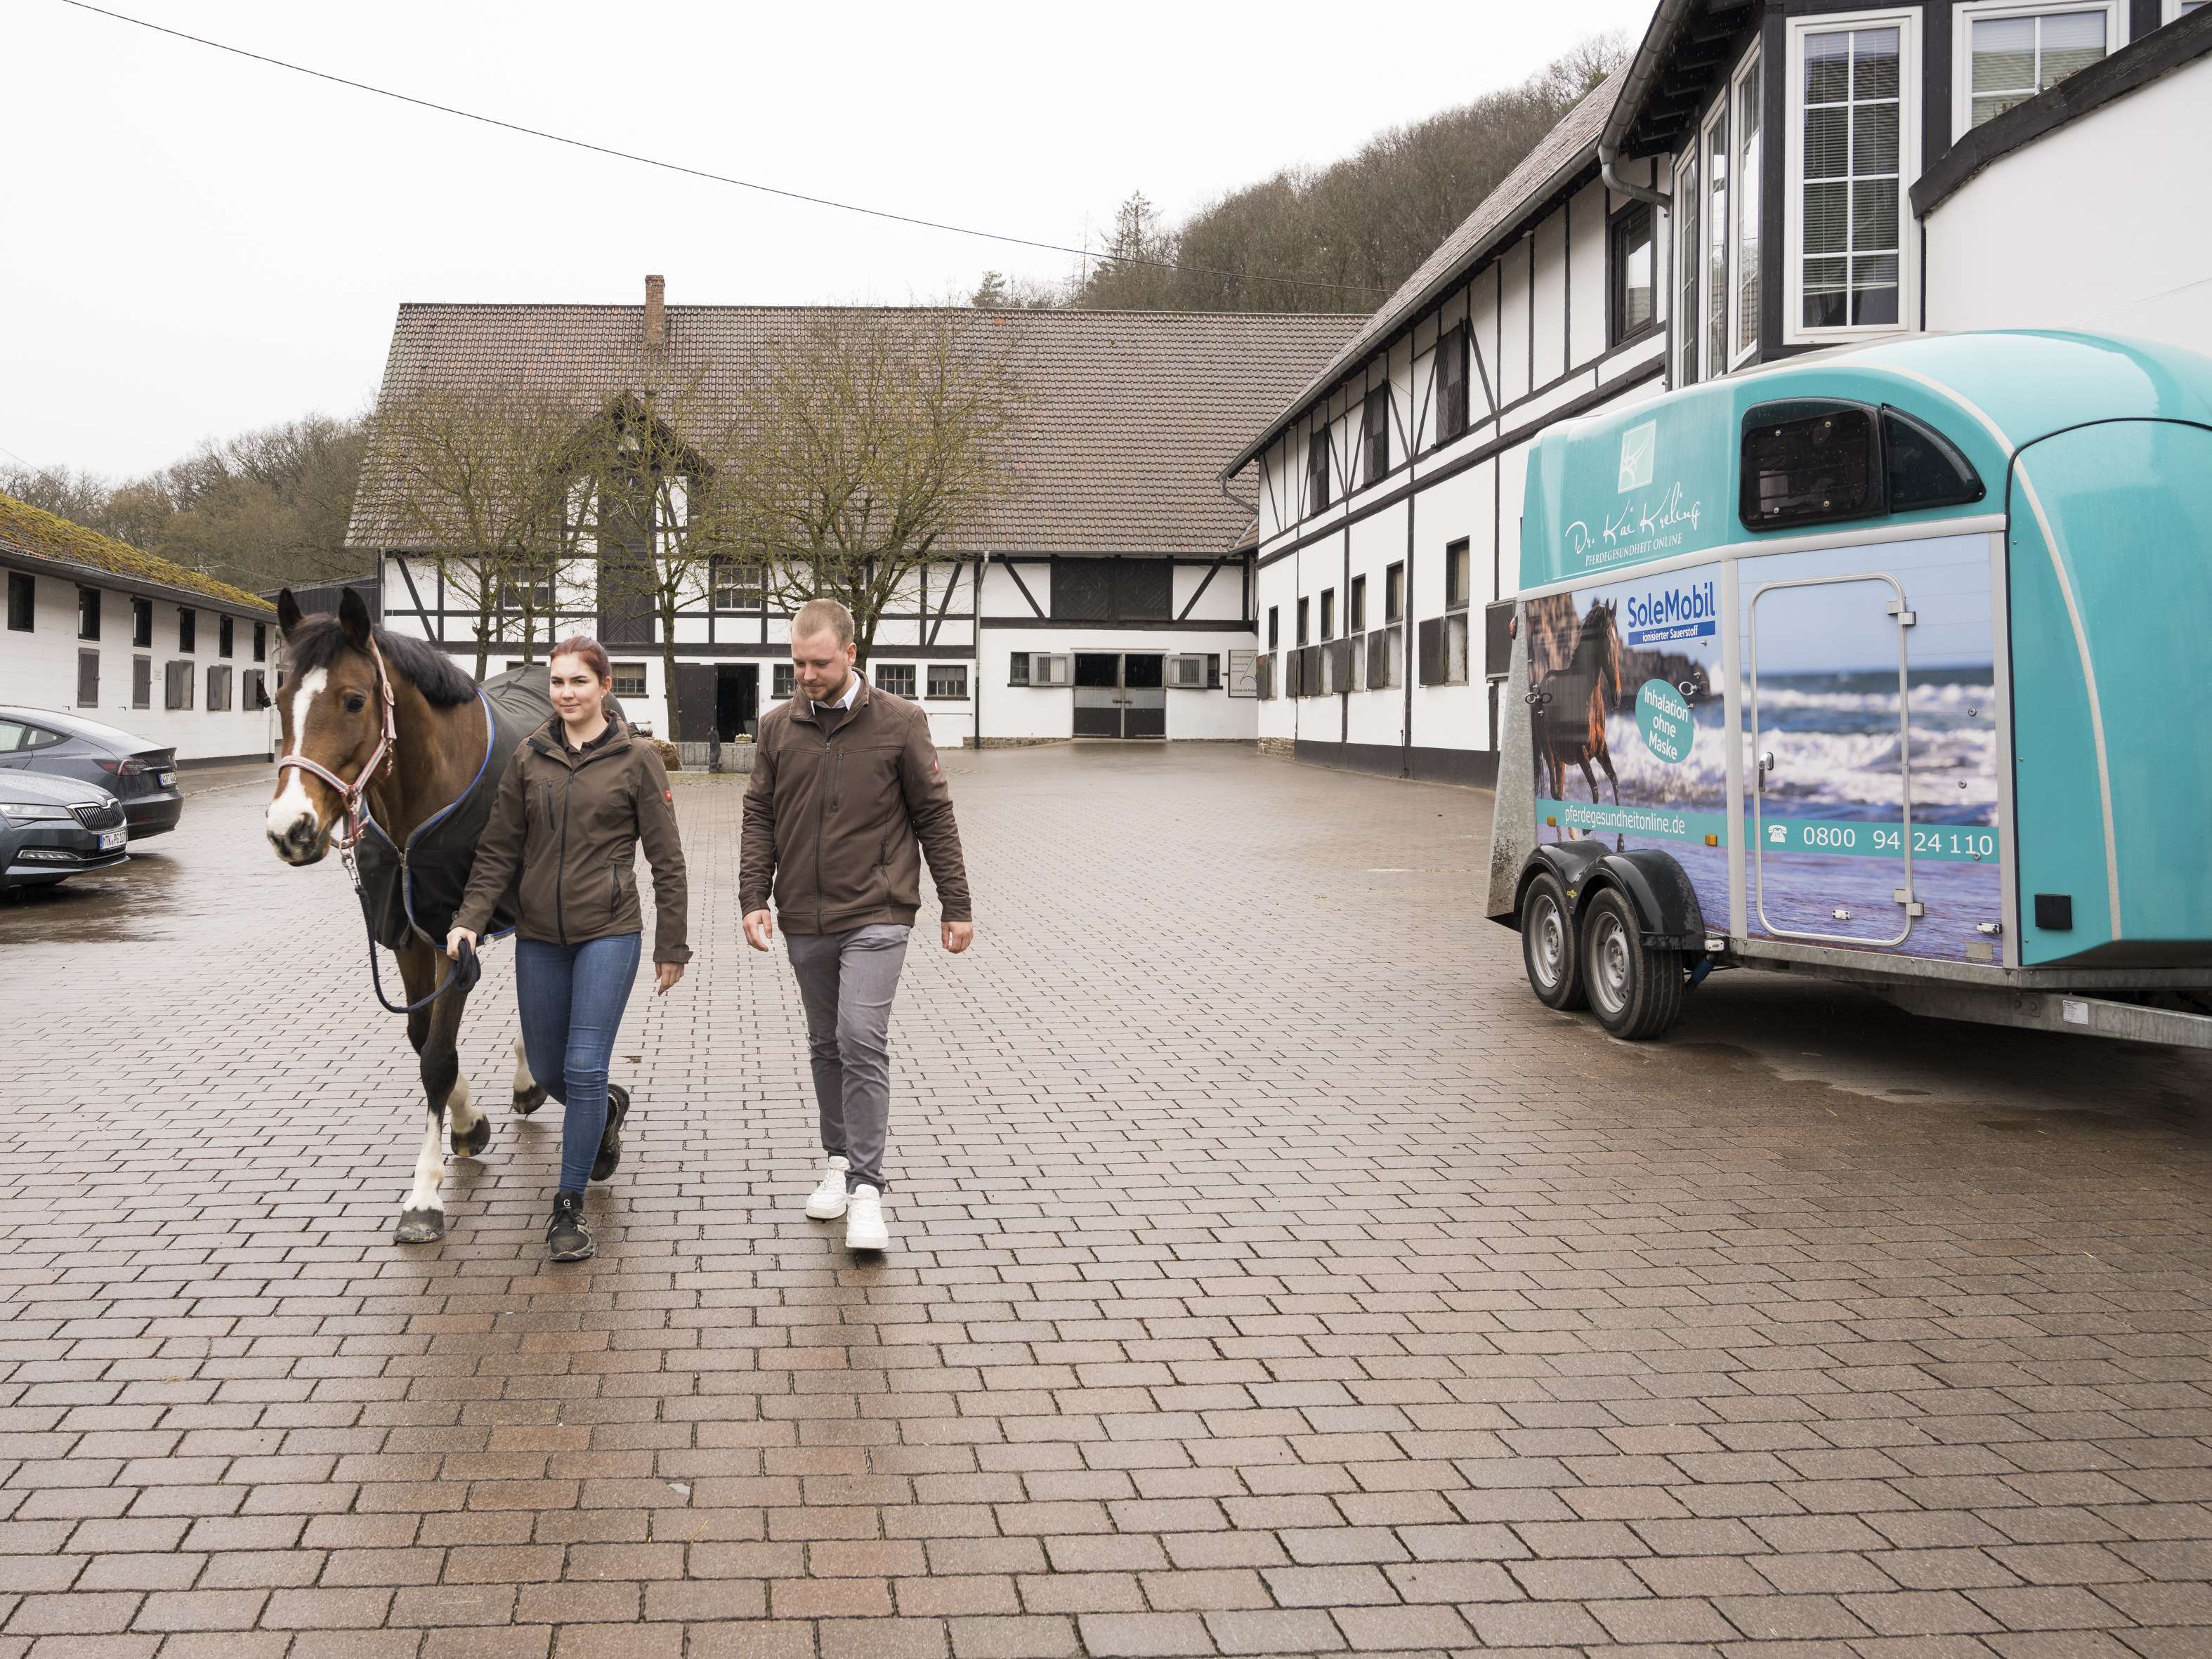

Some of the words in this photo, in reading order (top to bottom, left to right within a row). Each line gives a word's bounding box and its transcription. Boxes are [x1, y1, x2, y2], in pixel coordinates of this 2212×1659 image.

[1565, 520, 1595, 554] Dr.
[1602, 499, 1635, 546] Kai
[1585, 539, 1651, 566] PFERDEGESUNDHEIT
[1653, 532, 1682, 550] ONLINE
[1628, 582, 1715, 628] SoleMobil
[1642, 631, 1669, 643] ionisierter
[1670, 624, 1699, 638] Sauerstoff
[1644, 686, 1689, 723] Inhalation
[1653, 714, 1676, 737] ohne
[1649, 730, 1677, 761] Maske
[1565, 806, 1686, 834] pferdegesundheitonline.de
[1803, 827, 1855, 847] 0800
[1873, 830, 1900, 850] 94
[1913, 832, 1942, 852] 24
[1949, 834, 1993, 855] 110
